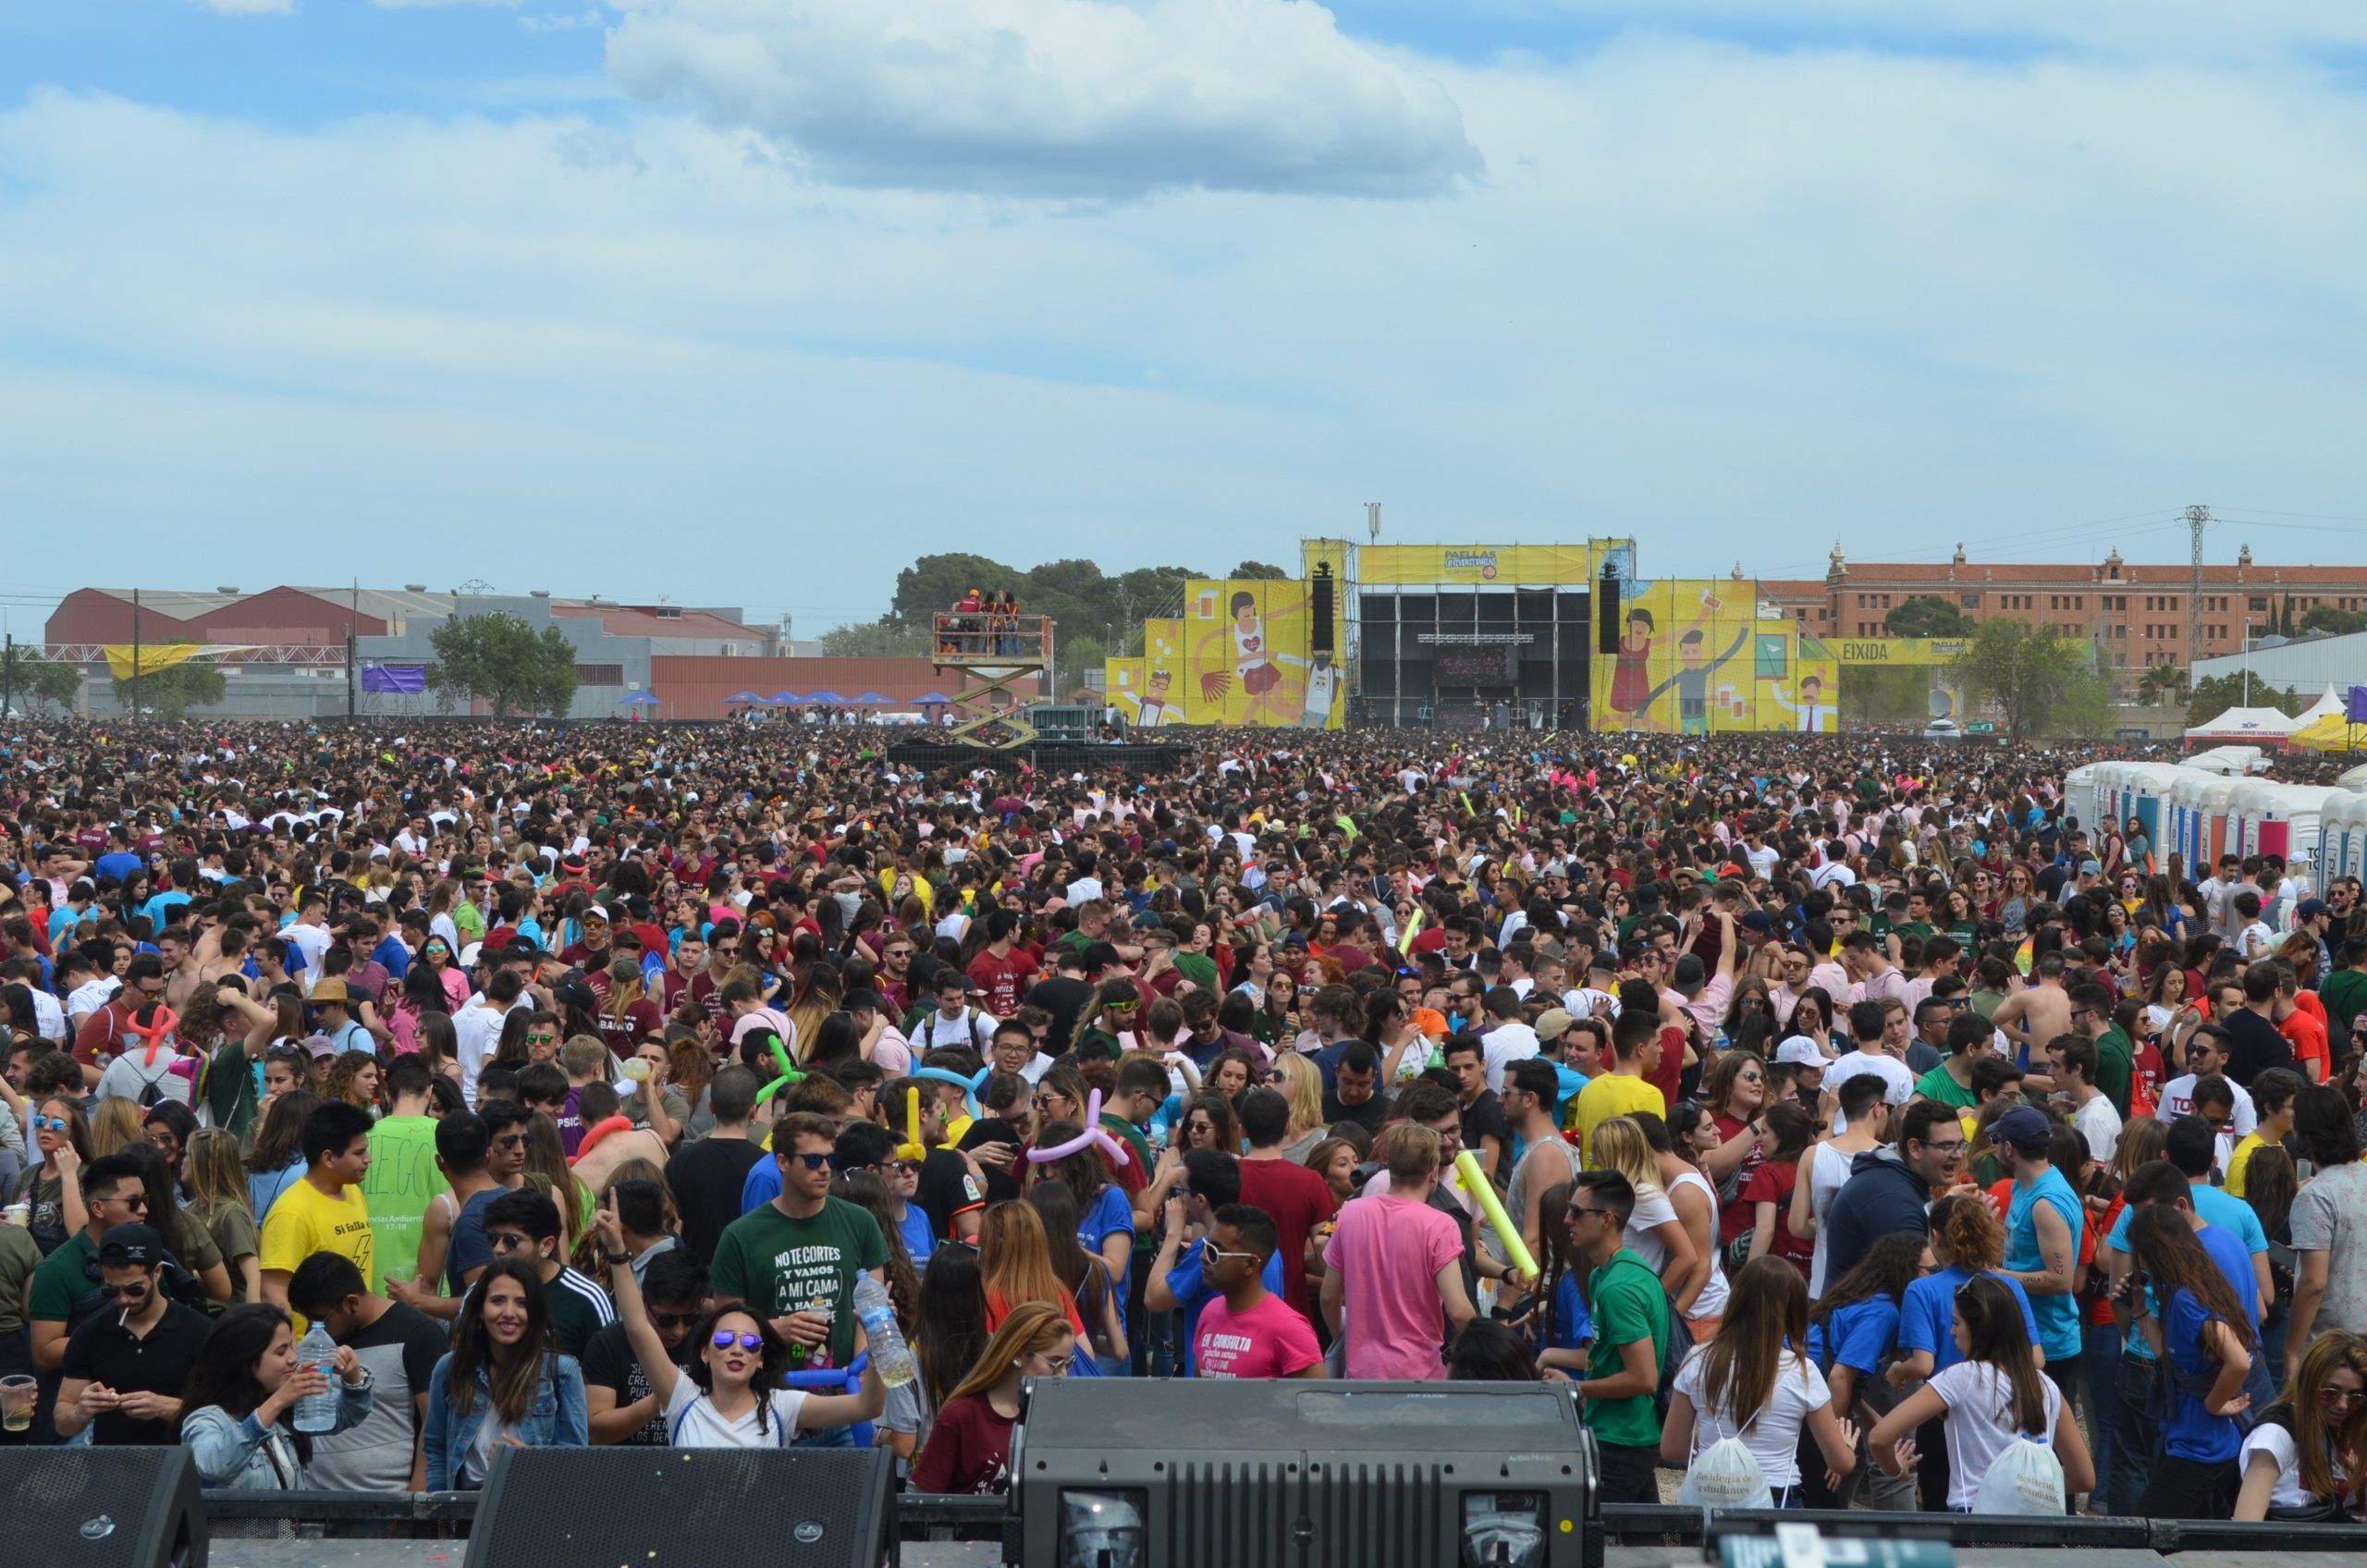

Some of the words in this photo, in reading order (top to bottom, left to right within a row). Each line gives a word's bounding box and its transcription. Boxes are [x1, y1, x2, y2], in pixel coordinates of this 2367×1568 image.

[1444, 550, 1496, 558] PAELLAS
[1843, 643, 1888, 660] EIXIDA
[363, 1134, 432, 1197] IEGO
[335, 1224, 346, 1236] Si
[346, 1220, 366, 1232] falla
[775, 1251, 790, 1268] NO
[790, 1247, 803, 1266] TE
[802, 1245, 841, 1264] CORTES
[783, 1269, 792, 1280] Y
[793, 1265, 834, 1278] VAMOS
[779, 1285, 787, 1298] A
[789, 1280, 803, 1298] MI
[805, 1279, 839, 1296] CAMA
[784, 1302, 792, 1312] A
[794, 1298, 833, 1311] HACR
[1201, 1333, 1213, 1347] EN
[1213, 1333, 1252, 1353] CONSULTA
[977, 1480, 988, 1488] de
[1696, 1471, 1740, 1483] Residencia
[1742, 1473, 1752, 1483] de
[1698, 1484, 1750, 1495] estudiantes
